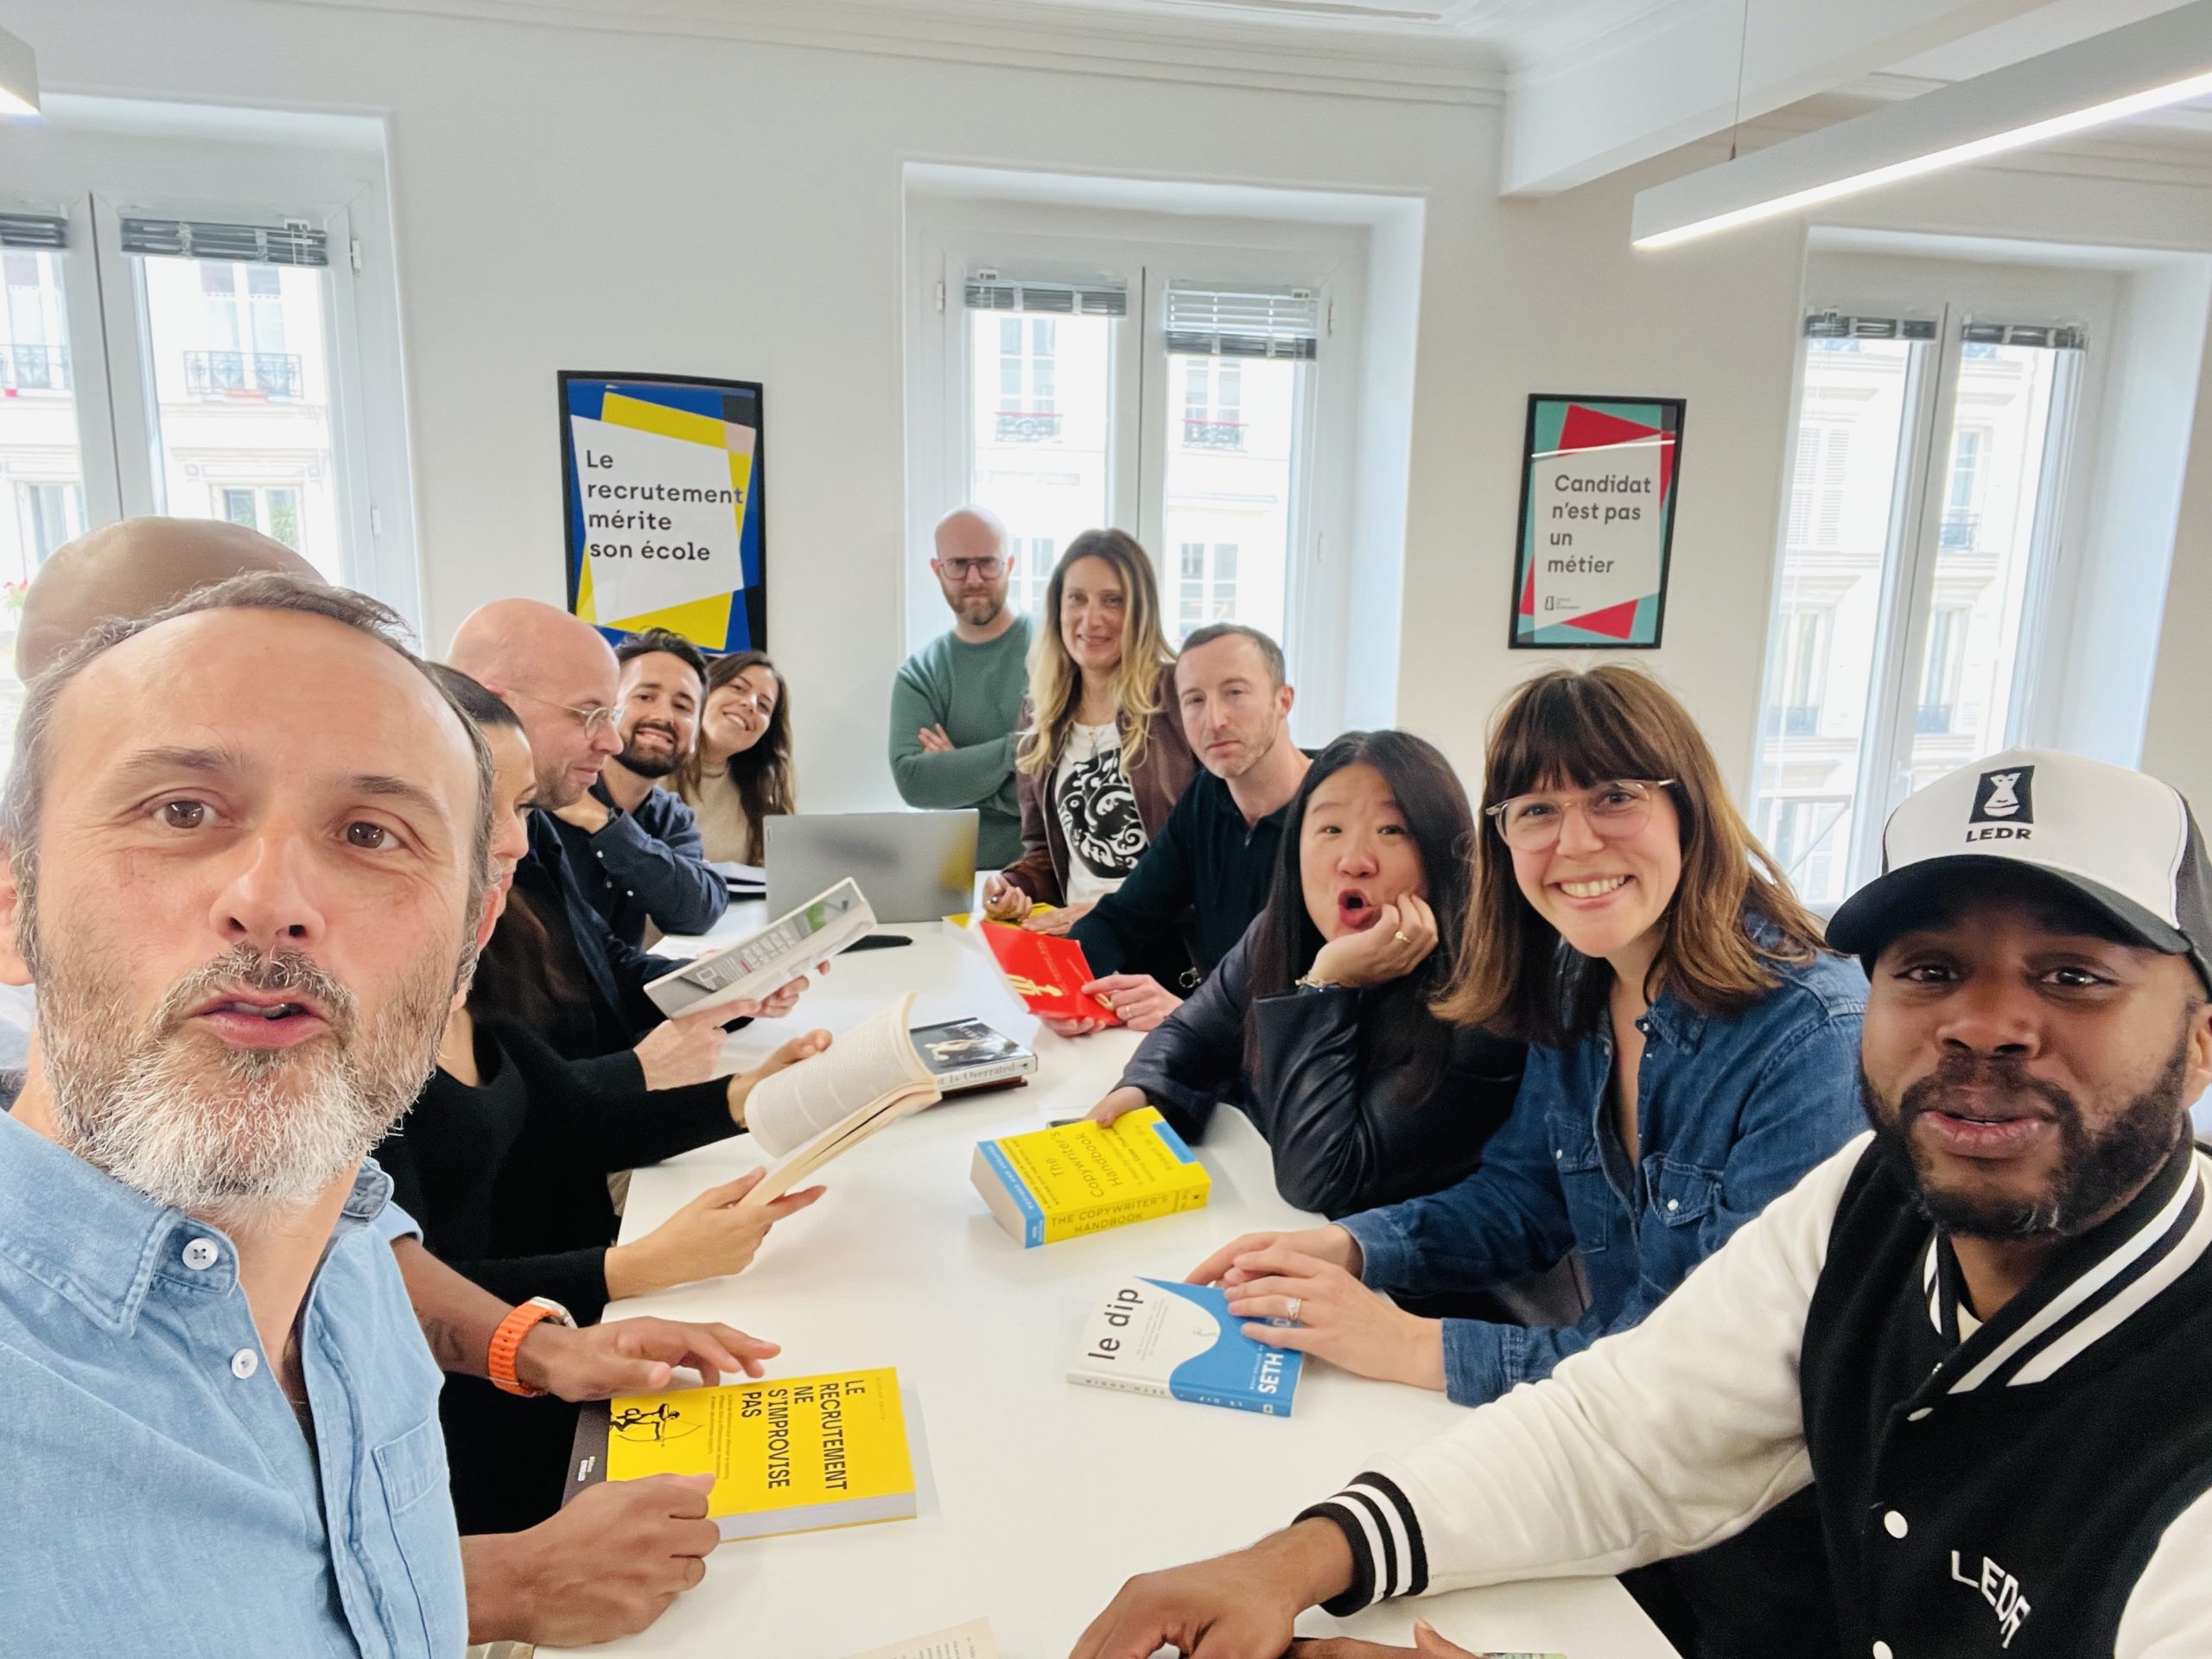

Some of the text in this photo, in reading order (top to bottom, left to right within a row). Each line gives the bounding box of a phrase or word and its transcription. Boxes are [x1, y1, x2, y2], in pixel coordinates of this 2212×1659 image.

[587, 449, 613, 468] Le
[588, 483, 744, 504] recrutement
[1554, 474, 1651, 493] Candidat
[588, 510, 672, 531] mérite
[1605, 505, 1641, 524] pas
[1550, 532, 1573, 546] un
[589, 540, 710, 561] son école
[1548, 556, 1614, 574] métier
[1965, 828, 2032, 842] LEDR
[963, 1062, 1015, 1079] Overrated
[1046, 1158, 1065, 1178] The
[1075, 1132, 1123, 1187] Handbook
[1052, 1215, 1074, 1227] THE
[1078, 1194, 1168, 1221] COPYWRITER'S
[1074, 1212, 1143, 1234] HANDBOOK
[1088, 1288, 1144, 1360] le dip
[1257, 1352, 1284, 1394] SETH
[792, 1385, 814, 1404] NE
[844, 1379, 865, 1396] LE
[741, 1390, 762, 1418] PAS
[766, 1389, 791, 1490] S'IMPROVISE
[818, 1382, 848, 1491] RECRUTEMENT
